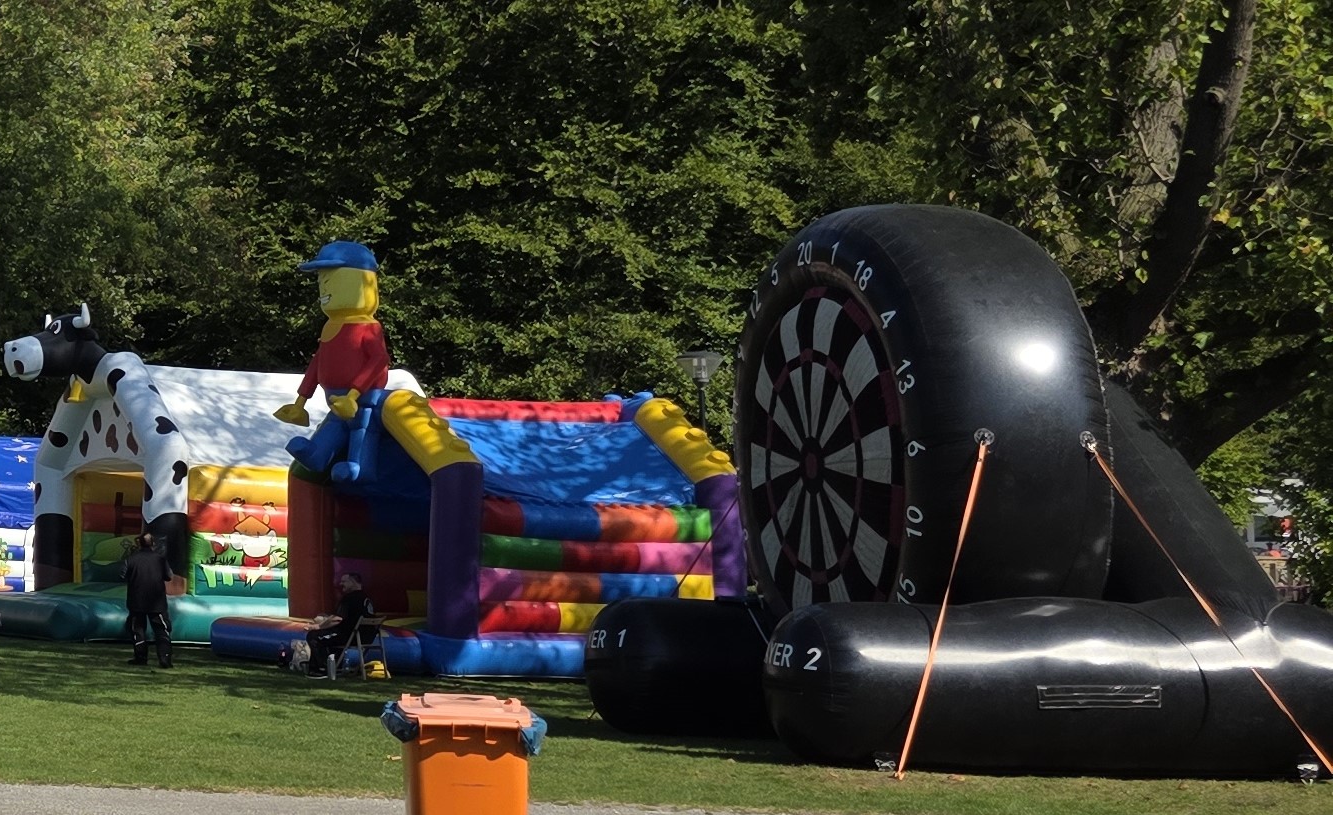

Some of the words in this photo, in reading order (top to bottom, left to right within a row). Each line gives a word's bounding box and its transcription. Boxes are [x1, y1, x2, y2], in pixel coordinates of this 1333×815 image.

[797, 240, 813, 267] 20
[831, 241, 840, 265] 1
[771, 262, 779, 286] 5
[853, 259, 873, 291] 18
[880, 310, 897, 329] 4
[895, 359, 915, 395] 13
[906, 505, 924, 538] 10
[896, 572, 916, 604] 15
[618, 628, 627, 648] 1
[803, 647, 822, 671] 2
